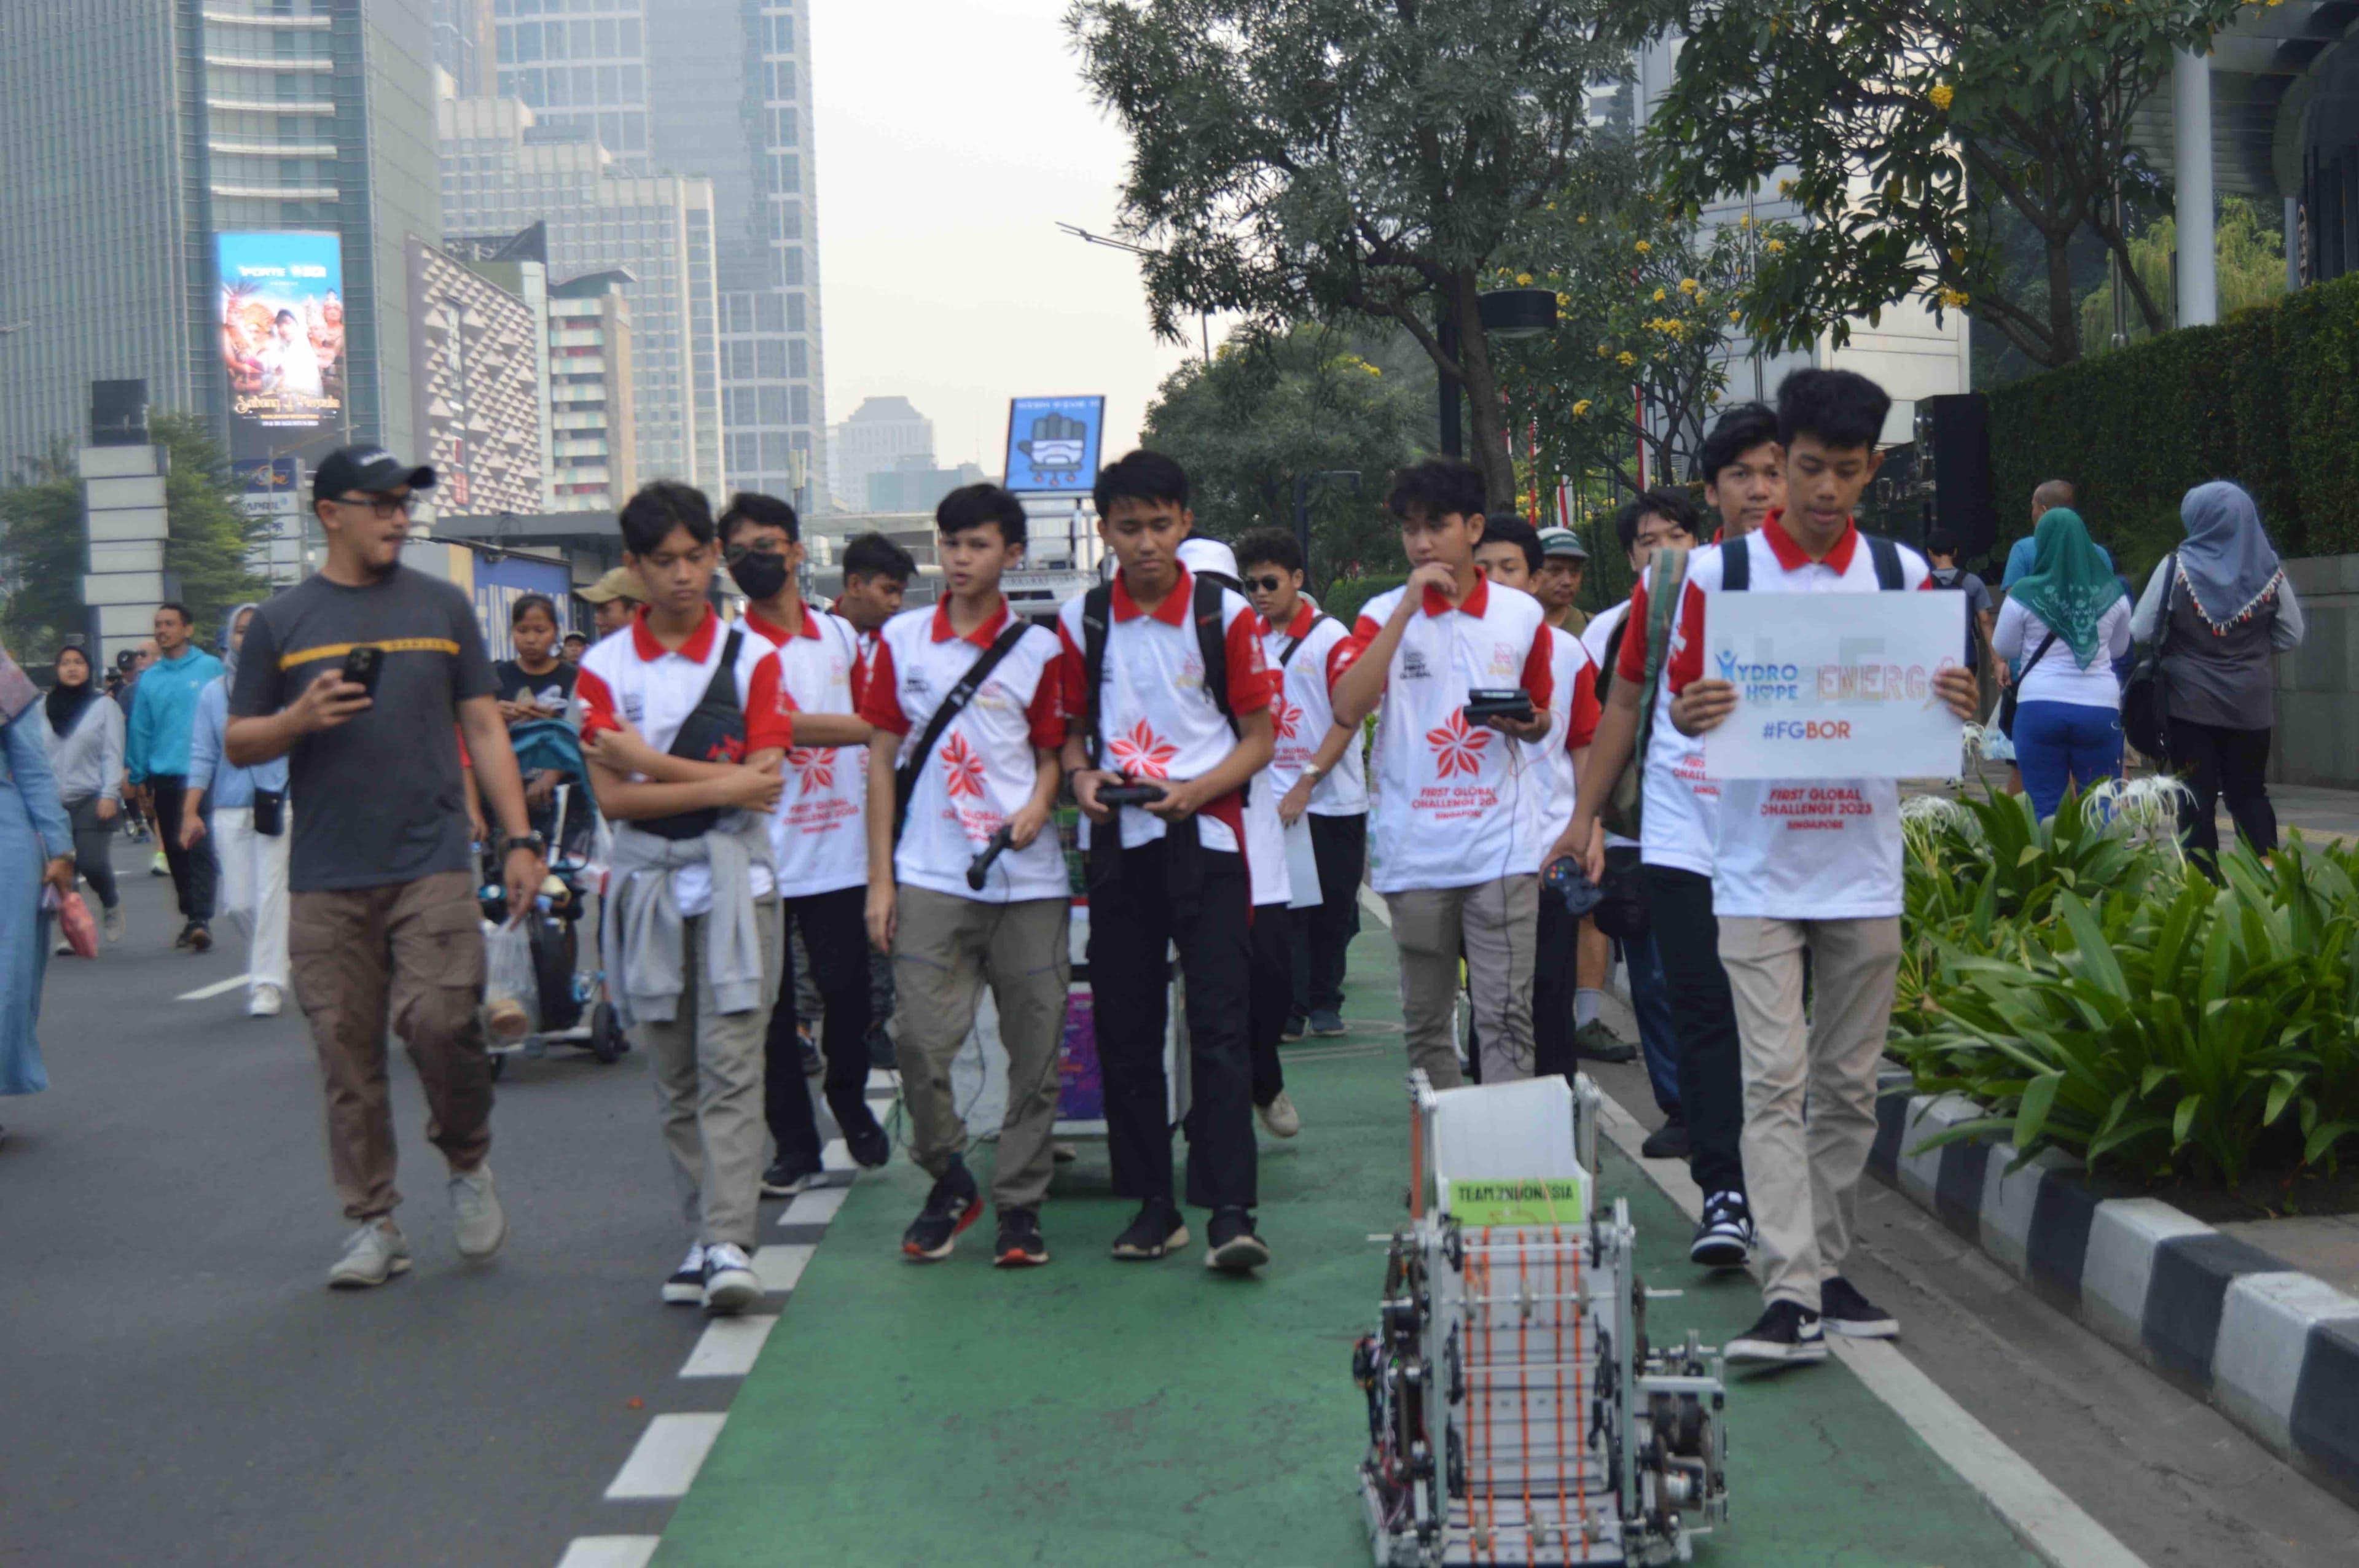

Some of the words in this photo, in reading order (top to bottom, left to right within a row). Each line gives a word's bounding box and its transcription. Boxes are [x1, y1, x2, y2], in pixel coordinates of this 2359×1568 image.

[1746, 684, 1798, 700] HOPE
[1762, 720, 1851, 739] #FGBOR
[1421, 787, 1449, 797] FIRST
[1769, 789, 1805, 800] FIRST
[1809, 788, 1862, 800] GLOBAL
[1761, 802, 1835, 815] CHALLENGE
[1458, 1184, 1495, 1202] TEAM
